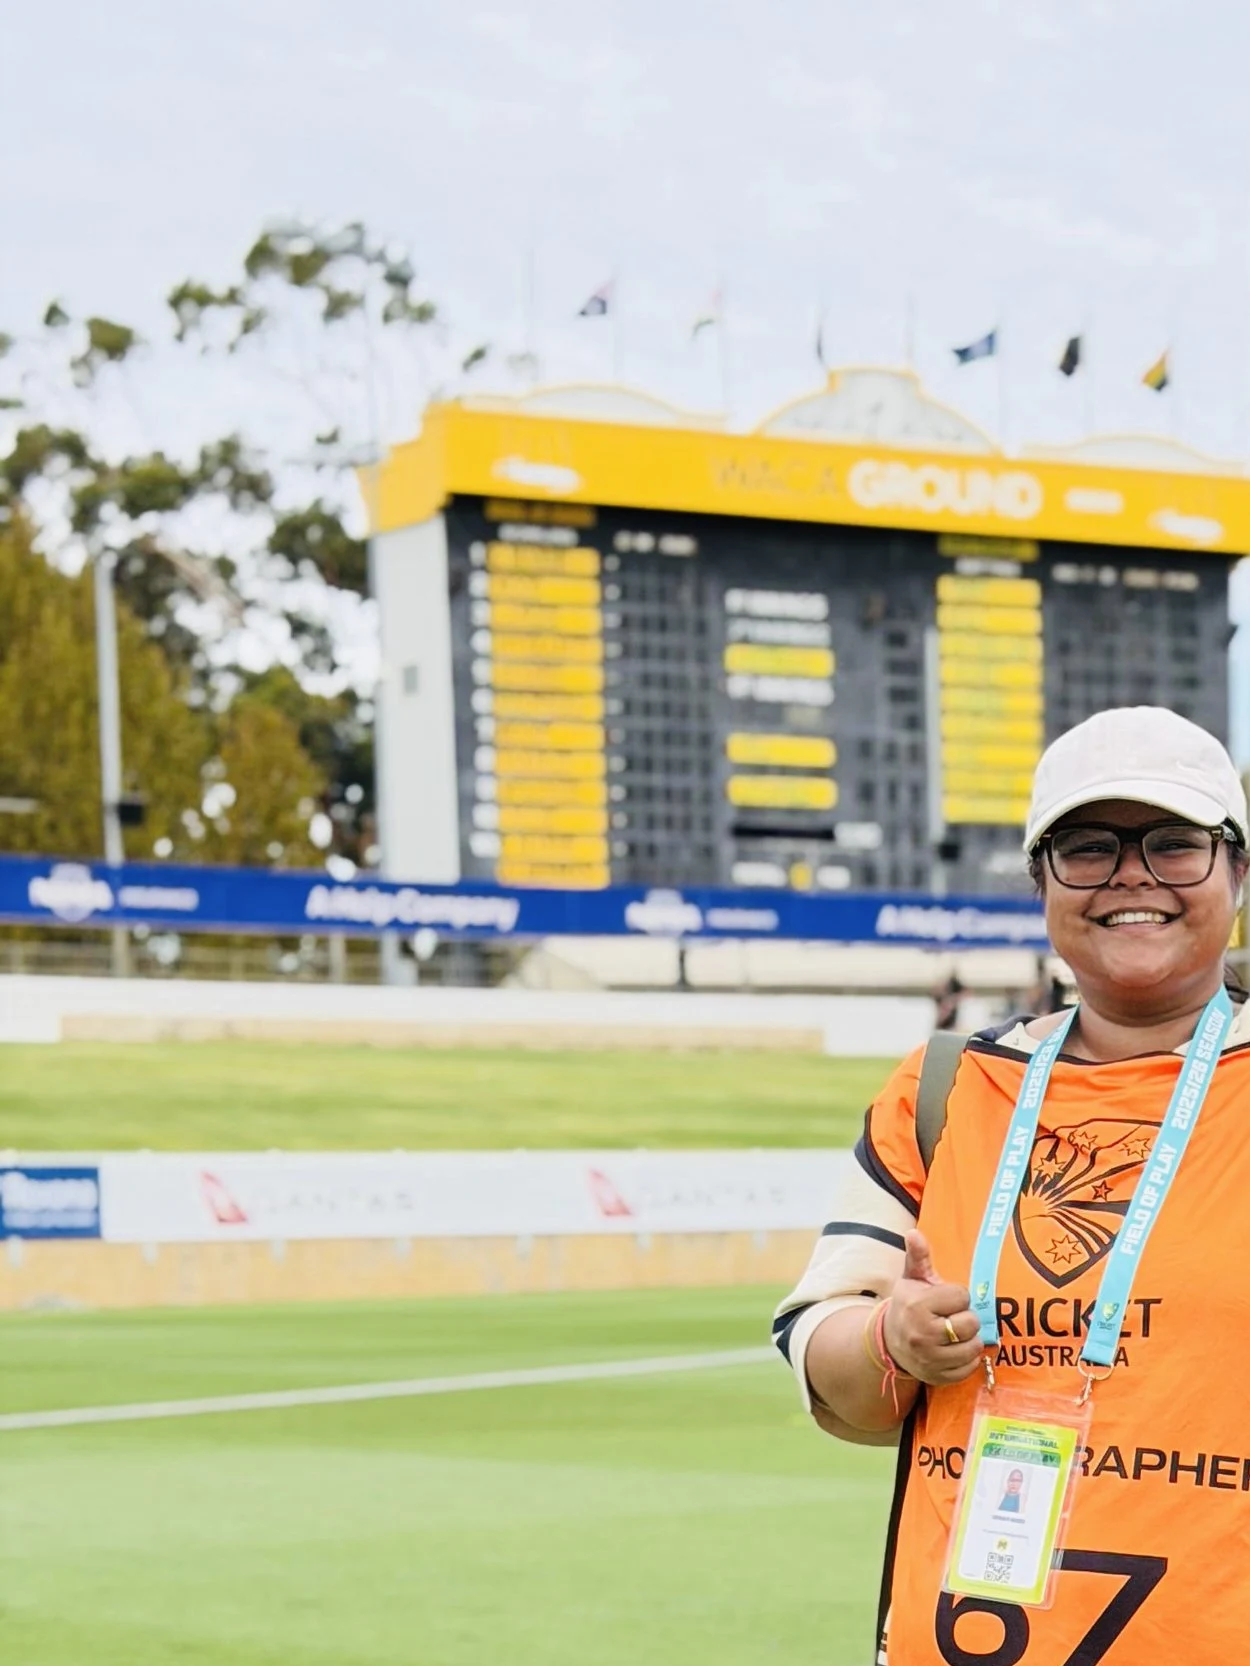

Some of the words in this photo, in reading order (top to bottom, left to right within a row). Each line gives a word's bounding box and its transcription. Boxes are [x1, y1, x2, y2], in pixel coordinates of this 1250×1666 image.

[851, 460, 1043, 520] GROUND
[1006, 1125, 1030, 1167] PLAY
[1119, 1206, 1152, 1255] FIELD
[1142, 1185, 1159, 1208] OF
[1151, 1142, 1179, 1186] PLAY
[1195, 1007, 1228, 1062] SEASON
[999, 1168, 1015, 1190] OF
[985, 1192, 1012, 1238] FIELD
[996, 1297, 1163, 1338] RICKT
[988, 1431, 1059, 1449] INTERNATIONAL
